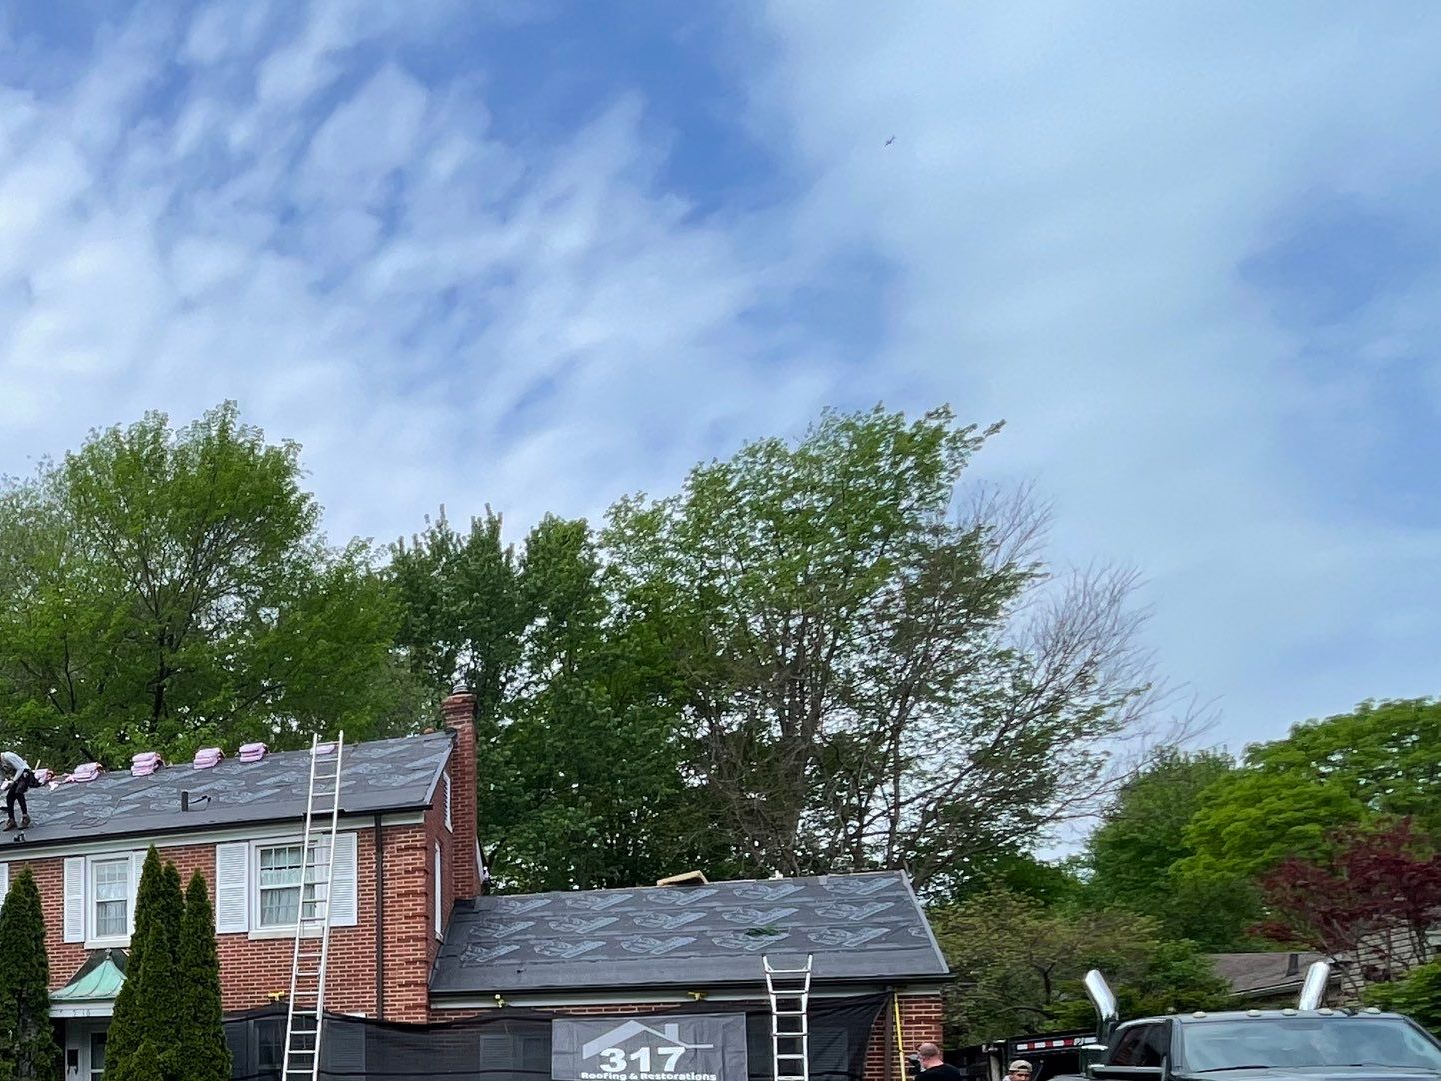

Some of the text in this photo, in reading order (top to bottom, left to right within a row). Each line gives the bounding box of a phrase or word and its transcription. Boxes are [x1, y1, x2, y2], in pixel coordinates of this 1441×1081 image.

[600, 1046, 686, 1073] 317
[581, 1072, 627, 1081] Roofing
[640, 1072, 717, 1081] Restorations
